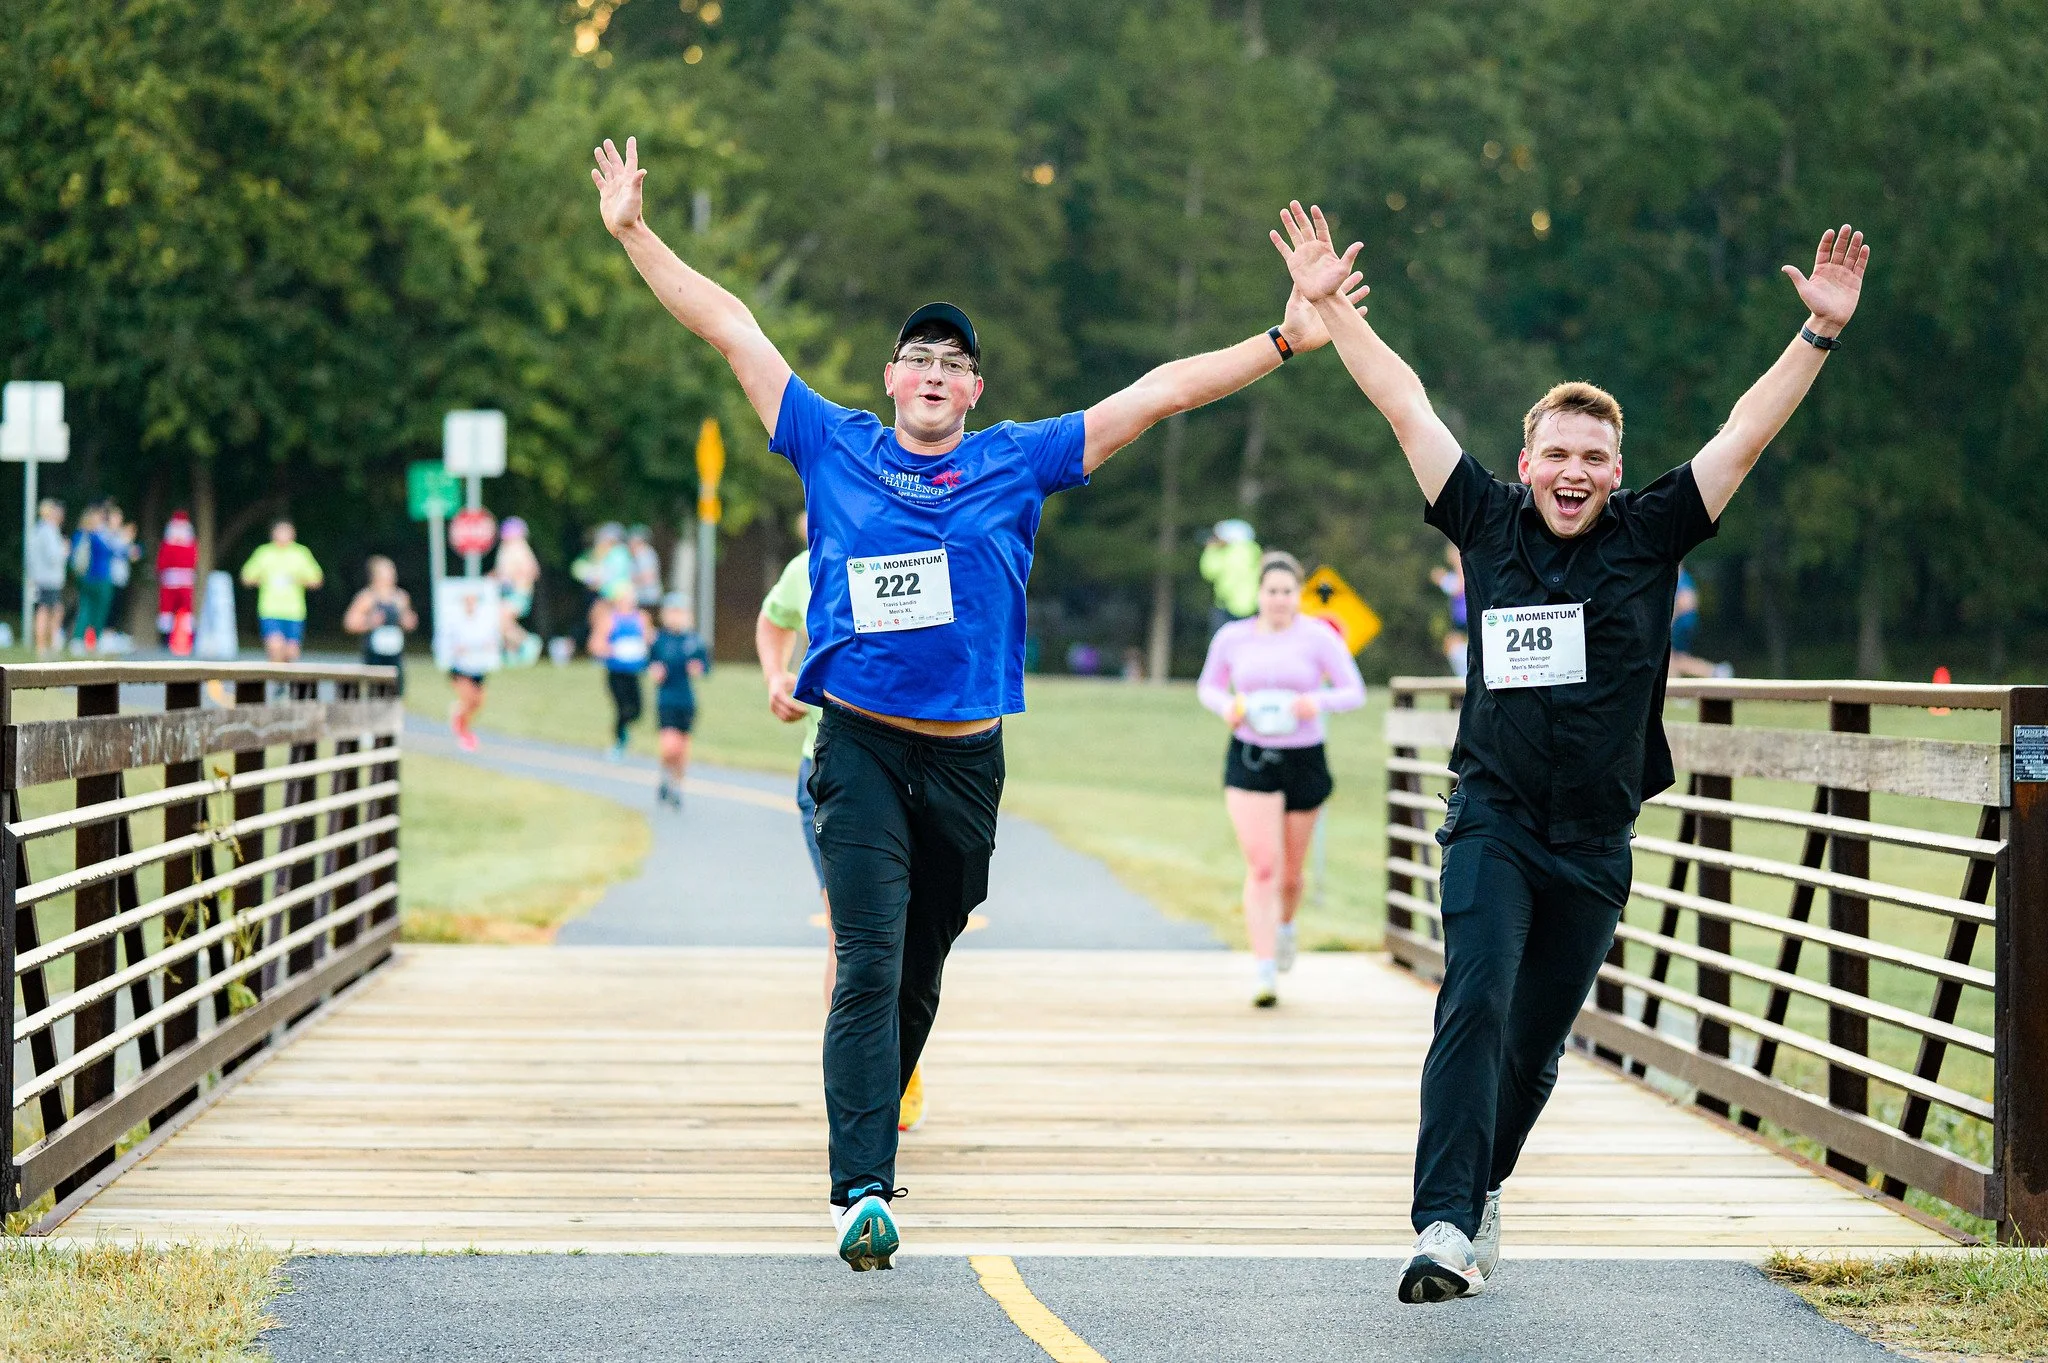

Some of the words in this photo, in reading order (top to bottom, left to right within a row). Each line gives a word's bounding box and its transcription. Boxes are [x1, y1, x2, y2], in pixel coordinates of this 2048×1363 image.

[884, 556, 942, 569] MOMENTUM
[875, 572, 921, 598] 222
[1502, 614, 1514, 622] VA
[1516, 610, 1576, 622] MOMENTUM
[1506, 626, 1553, 652] 248
